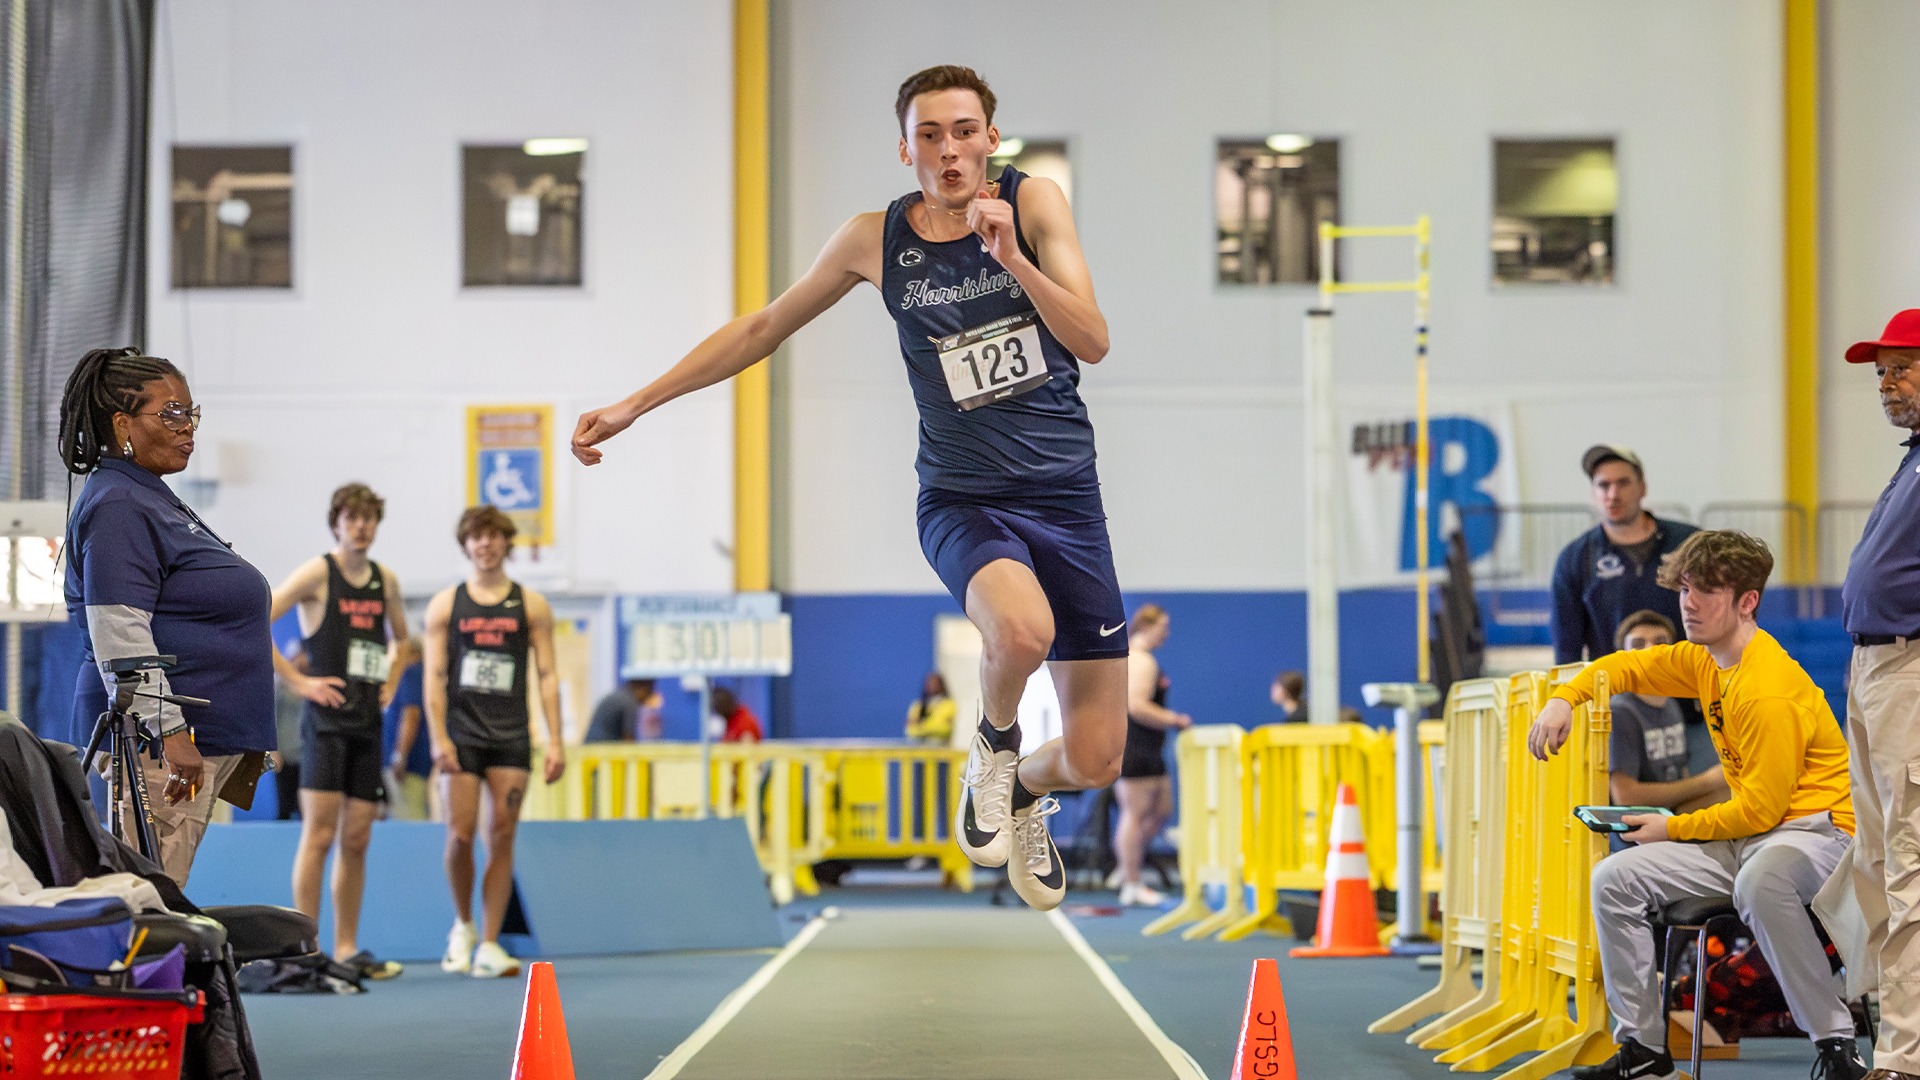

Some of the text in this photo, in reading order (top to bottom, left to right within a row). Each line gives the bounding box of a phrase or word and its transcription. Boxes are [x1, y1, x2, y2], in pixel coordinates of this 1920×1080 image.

[901, 267, 1022, 310] Harrisburg
[961, 336, 1029, 390] 123
[1254, 1011, 1278, 1080] GSLC
